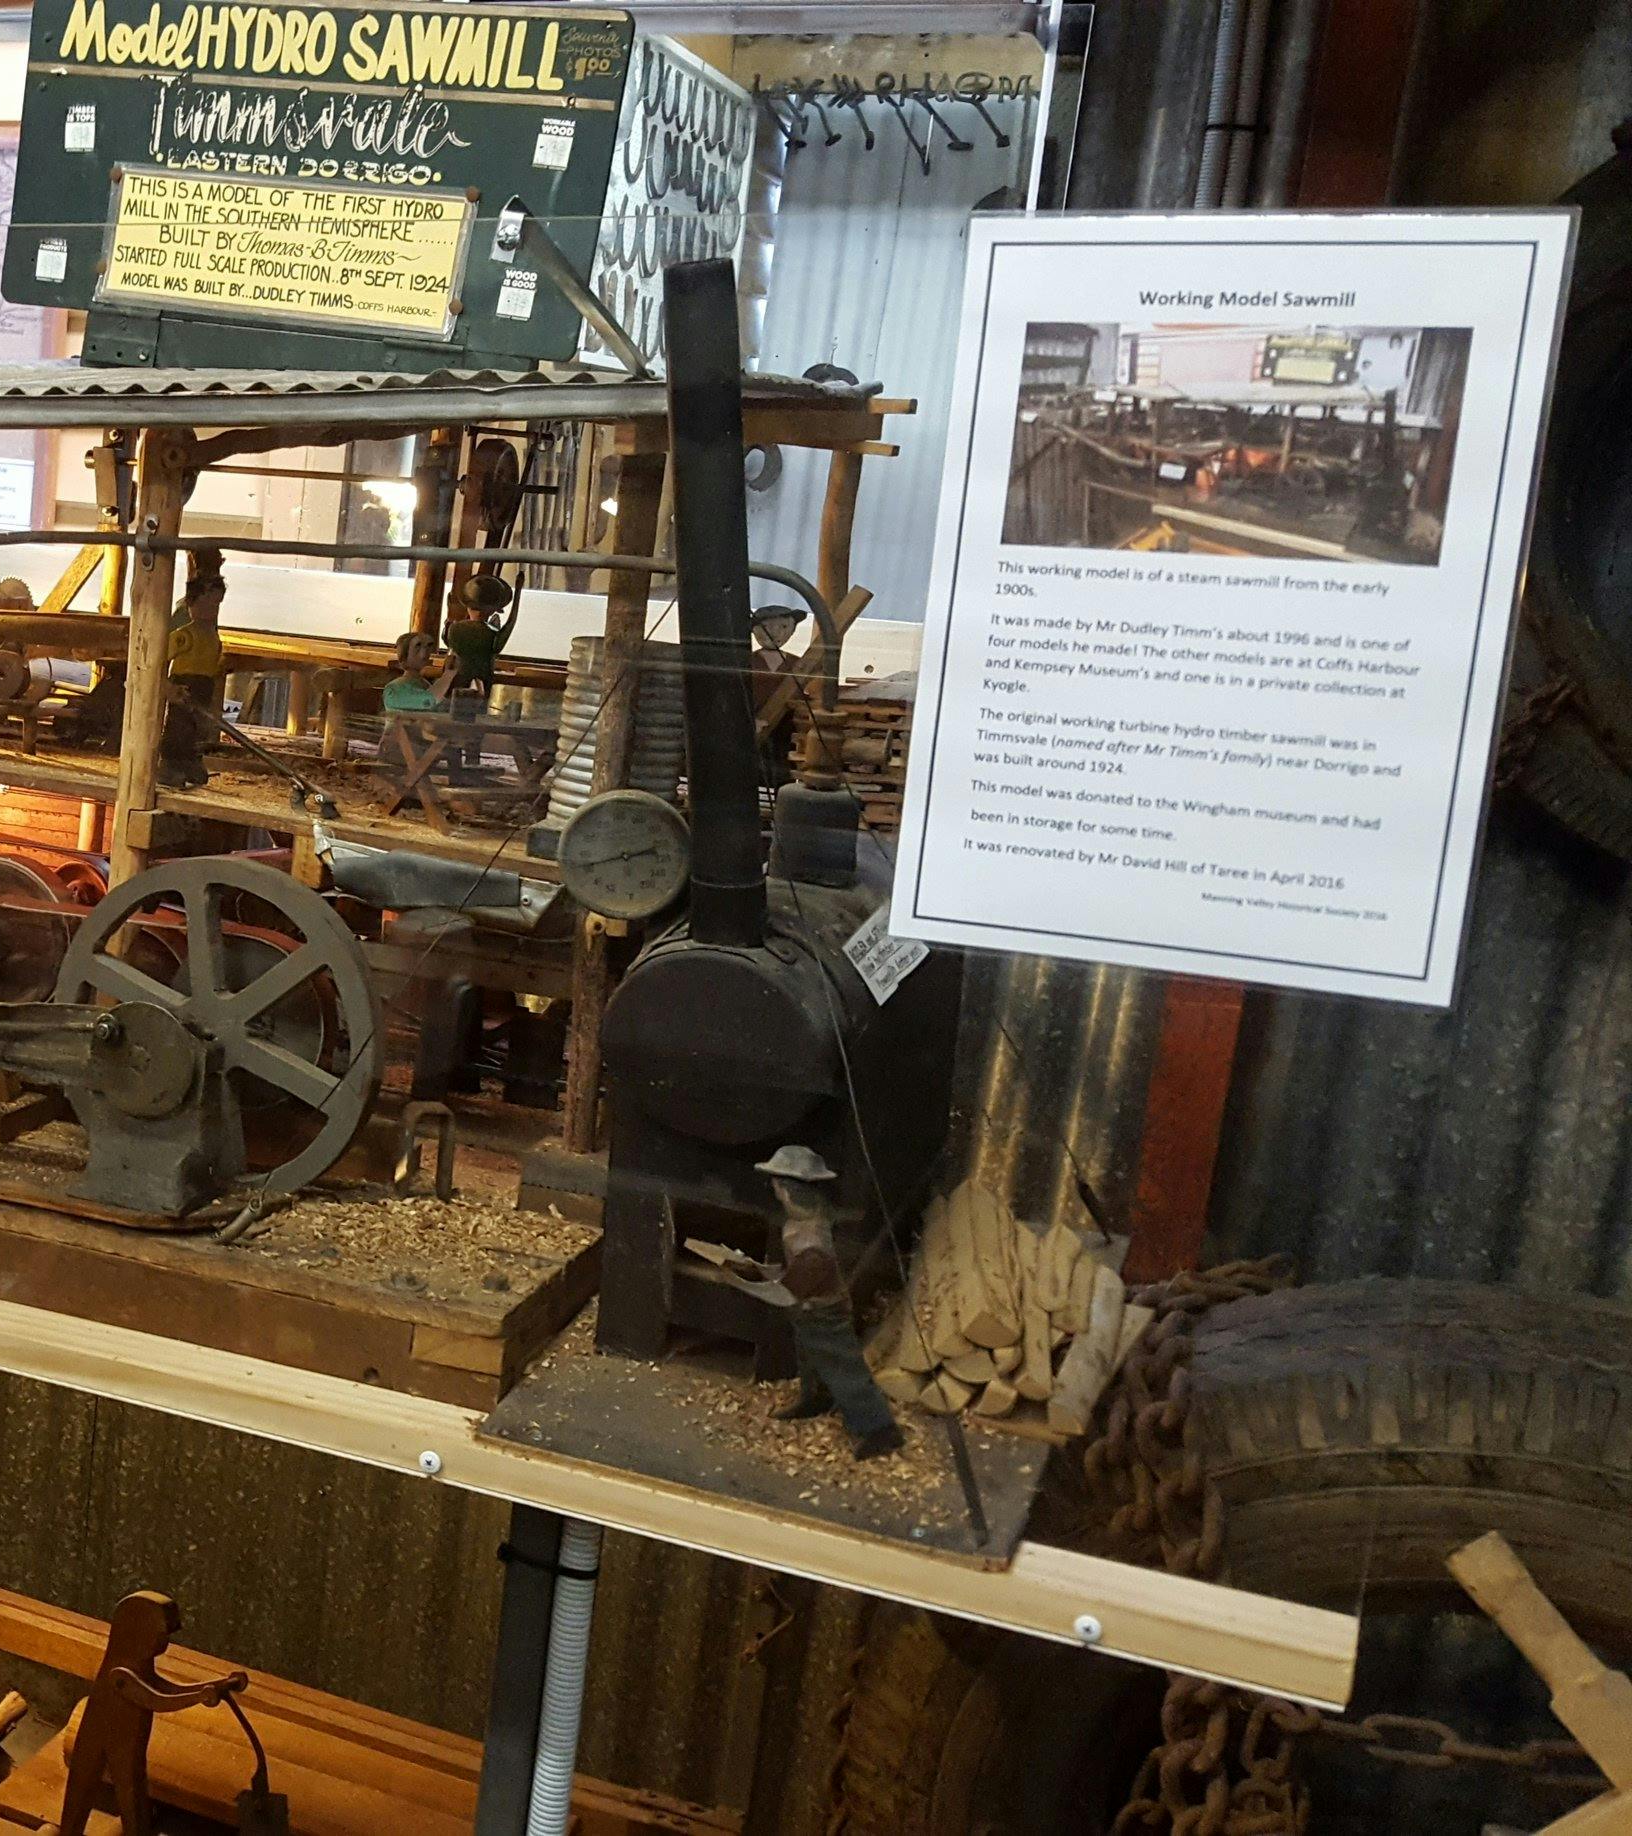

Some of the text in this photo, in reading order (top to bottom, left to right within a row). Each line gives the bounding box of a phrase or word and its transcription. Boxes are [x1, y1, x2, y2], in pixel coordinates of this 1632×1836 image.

[59, 0, 564, 91] Model HYDRO SAWMILL
[76, 113, 96, 122] TOPS
[139, 71, 471, 158] Timmsvale
[542, 124, 575, 136] WOOD
[166, 148, 287, 176] EASTERN
[124, 198, 158, 218] MILL
[164, 202, 178, 219] IN
[185, 203, 211, 224] THE
[217, 208, 303, 231] SOUTHERN
[129, 176, 444, 220] THIS IS A MODEL OF THE FIRST HYDRO
[158, 224, 210, 247] BUILT
[216, 231, 237, 250] BY
[114, 244, 166, 266] STARTED
[173, 251, 200, 269] FULL
[207, 254, 246, 273] SCALE
[363, 269, 404, 288] SEPT.
[409, 274, 447, 293] 1924
[505, 270, 537, 281] WOOD
[511, 280, 536, 289] GOOD
[120, 272, 159, 288] MODEL
[163, 276, 187, 291] WAS
[193, 279, 224, 295] BUILT
[252, 285, 305, 302] DUDLEY
[309, 291, 353, 308] TIMMS
[1138, 289, 1356, 310] Working Model Sawmill
[997, 560, 1390, 597] This working model is of a steam sawmill from the early
[990, 612, 1000, 626] It
[1002, 615, 1030, 627] was
[1032, 616, 1072, 632] made
[1074, 617, 1093, 634] by
[1094, 618, 1117, 632] Mr
[1118, 620, 1169, 639] Dudley
[1226, 628, 1270, 643] about
[1273, 630, 1310, 645] 1996
[1313, 634, 1342, 648] and
[1344, 636, 1357, 649] is
[1359, 639, 1390, 651] one
[1392, 638, 1411, 652] of
[987, 633, 1016, 648] four
[1018, 637, 1069, 652] models
[1071, 639, 1090, 653] he
[1141, 644, 1168, 658] The
[1170, 647, 1210, 661] other
[1212, 650, 1266, 666] models
[1269, 655, 1294, 668] are
[1296, 656, 1312, 669] at
[1314, 656, 1353, 672] Coffs
[1356, 659, 1421, 676] Harbour
[984, 656, 1011, 670] and
[1013, 657, 1075, 676] Kempsey
[1152, 669, 1181, 682] and
[1182, 672, 1211, 684] one
[1213, 671, 1226, 685] is
[1228, 674, 1243, 686] in
[1246, 676, 1255, 688] a
[1257, 676, 1310, 692] private
[1312, 680, 1386, 697] collection
[1388, 686, 1406, 698] at
[972, 752, 999, 763] was
[1002, 751, 1033, 767] built
[1036, 757, 1086, 771] around
[963, 837, 1345, 890] It was renovated by Mr David Hill of Taree in April 2016
